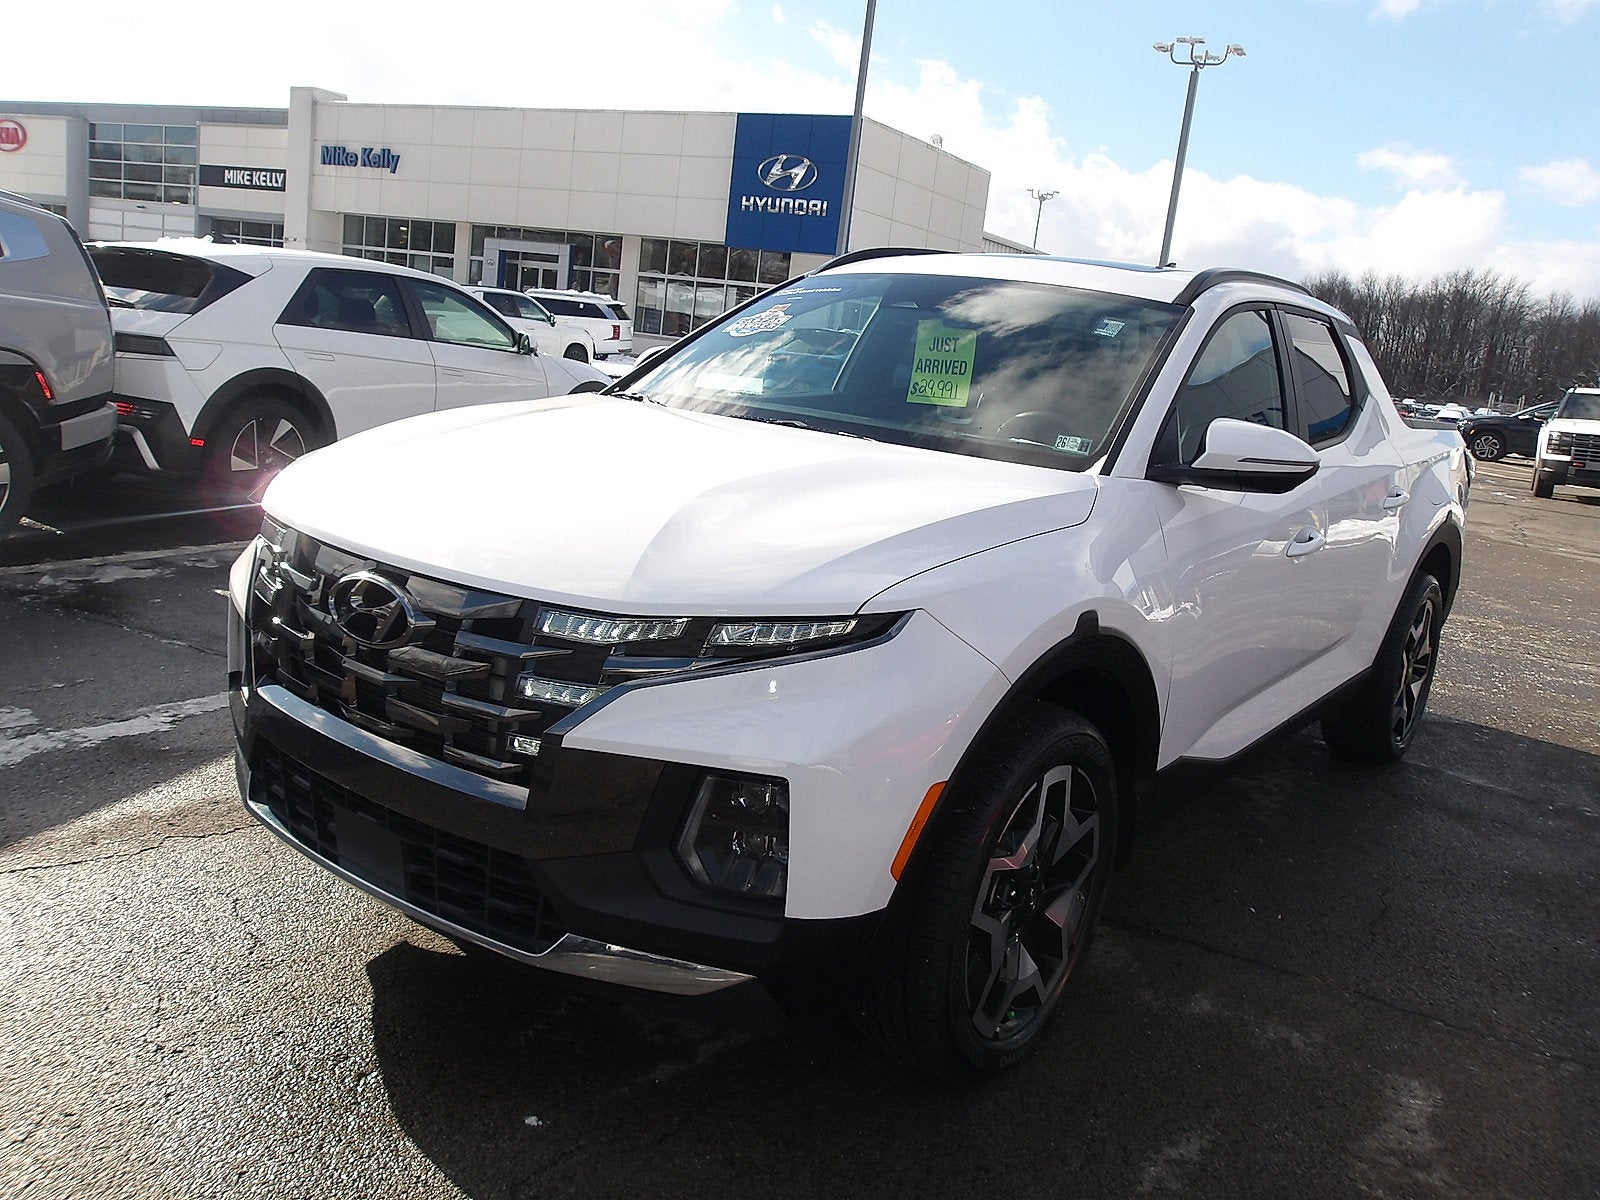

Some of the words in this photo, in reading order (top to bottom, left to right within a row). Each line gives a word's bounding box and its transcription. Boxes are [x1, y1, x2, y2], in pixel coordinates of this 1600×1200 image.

[320, 145, 358, 167] Mike
[360, 147, 401, 174] Kelly
[224, 169, 251, 185] MIKE
[252, 171, 285, 188] KELLY
[741, 195, 828, 217] HYUNDAI
[928, 336, 960, 353] JUST
[914, 358, 968, 376] ARRIVED
[1056, 436, 1068, 448] 26
